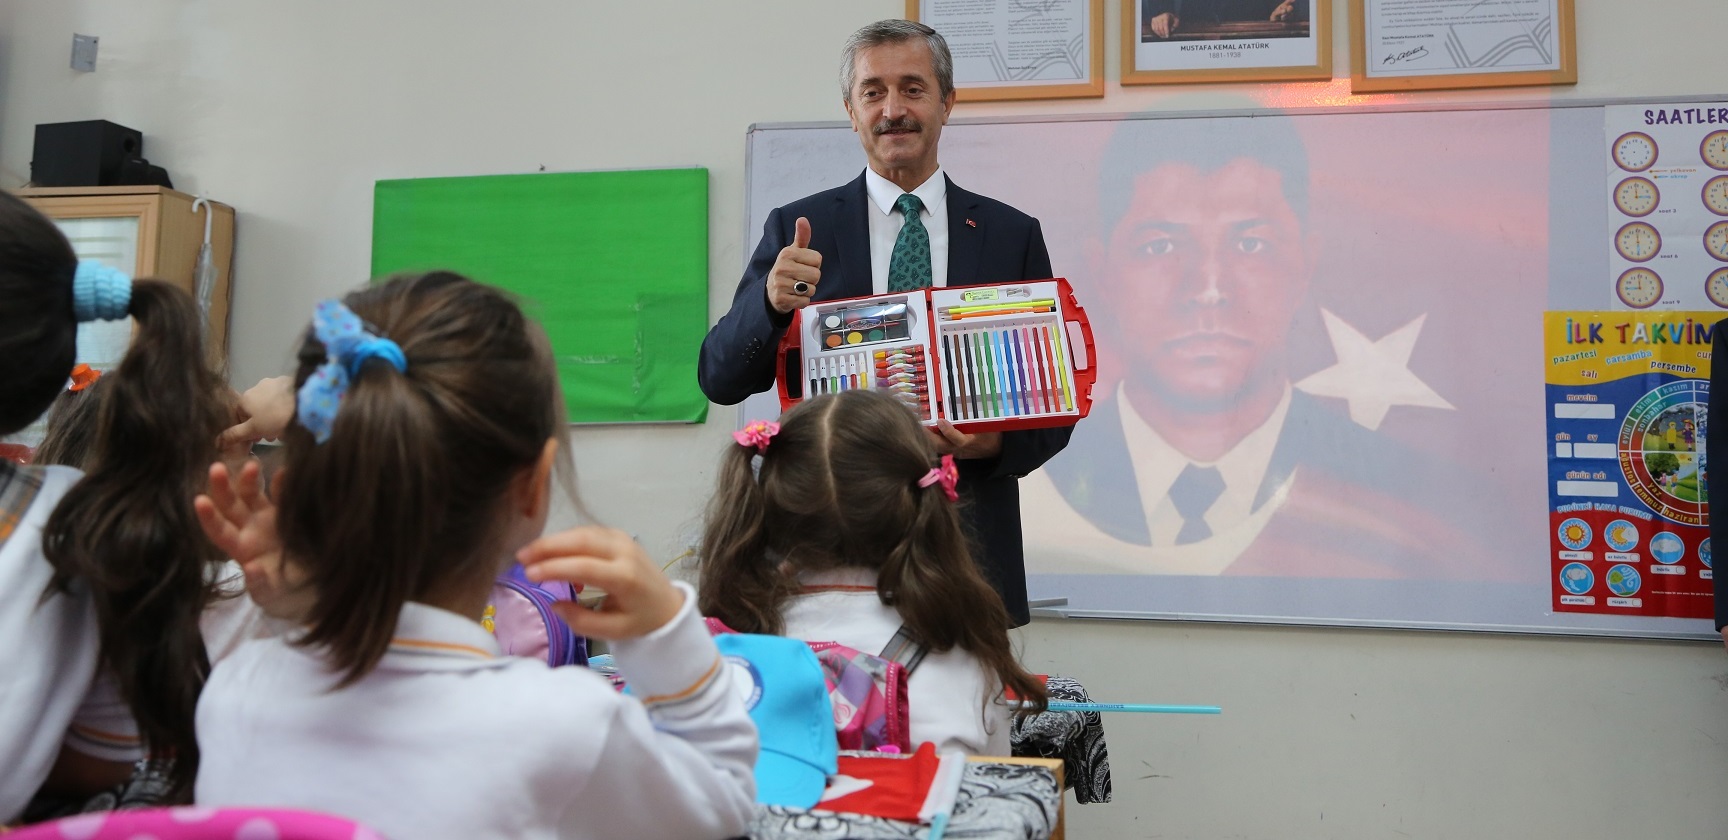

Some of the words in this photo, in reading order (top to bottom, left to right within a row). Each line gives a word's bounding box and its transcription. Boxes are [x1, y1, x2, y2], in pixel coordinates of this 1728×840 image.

[1644, 108, 1728, 125] SAATLER
[1566, 317, 1604, 344] İLK
[1553, 350, 1597, 365] pazartesi
[1605, 350, 1653, 365] çarşamba
[1581, 369, 1598, 379] salı
[1651, 360, 1697, 374] perşembe
[1662, 383, 1688, 394] kasım
[1567, 394, 1598, 402] mevsim
[1635, 397, 1652, 414] ekim
[1638, 401, 1667, 432] sonbahar
[1555, 432, 1571, 441] gün
[1587, 433, 1598, 442] ay
[1622, 424, 1632, 445] eylül
[1647, 482, 1662, 497] yaz
[1634, 484, 1663, 511] temmuz
[1663, 507, 1699, 524] haziran
